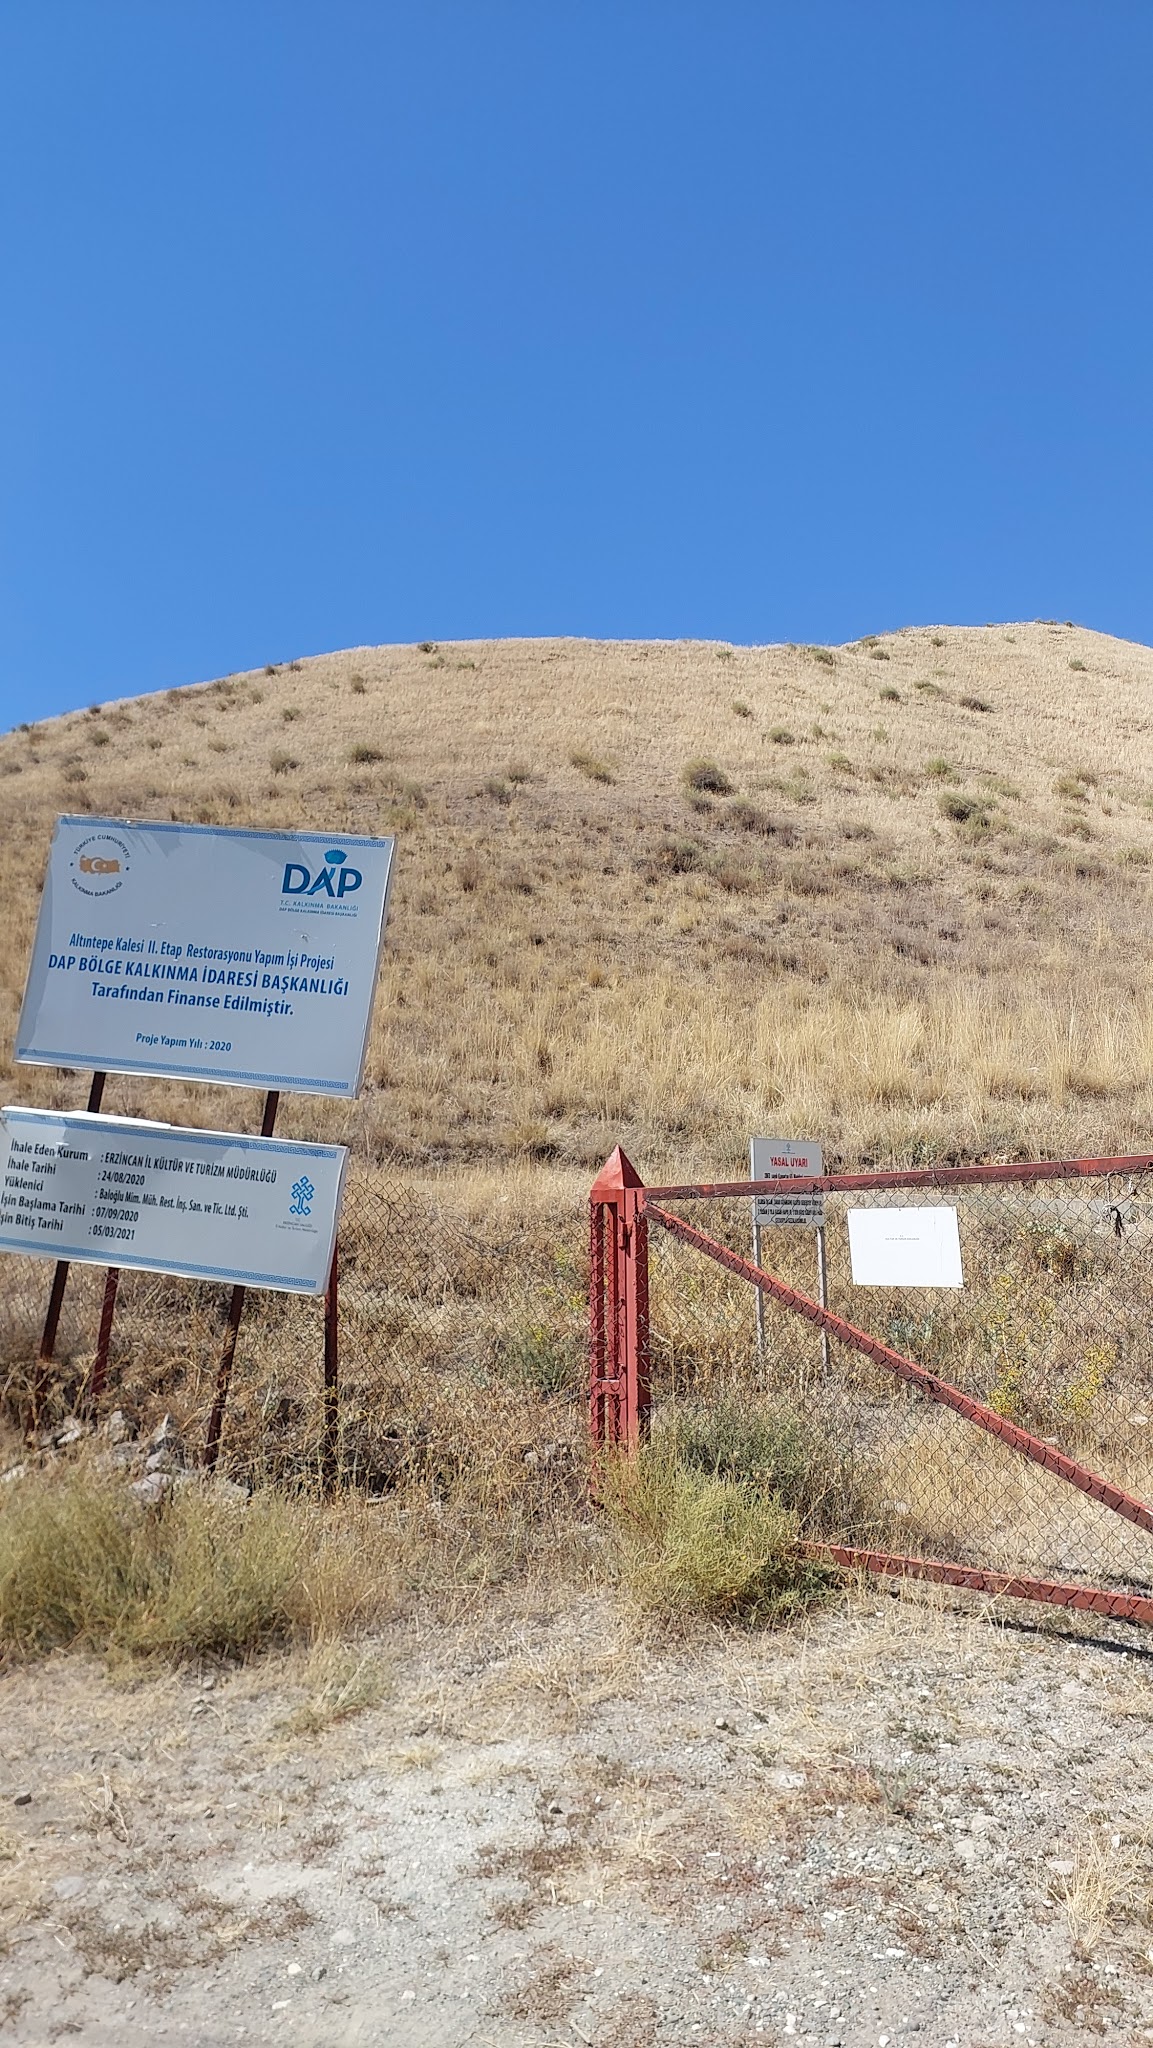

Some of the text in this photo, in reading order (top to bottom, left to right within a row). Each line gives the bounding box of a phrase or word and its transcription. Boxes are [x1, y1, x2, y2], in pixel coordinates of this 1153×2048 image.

[282, 863, 363, 898] DAP
[326, 903, 359, 912] BAKANLIĞI
[69, 933, 334, 972] Altıntepe Kalesi II. Etap Restorasyonu Yapım İşi Projesi
[48, 954, 349, 996] DAP BÖLGE KALKINMA İDARESİ BAŞKANLIĞI
[92, 982, 294, 1016] Tarafından Finanse Edilmiştir.
[136, 1032, 158, 1046] Proje
[160, 1035, 187, 1048] Yapım
[190, 1038, 202, 1048] Yılı
[209, 1040, 232, 1052] 2020
[7, 1156, 29, 1172] İhale
[32, 1161, 56, 1175] Tarihi
[102, 1170, 145, 1186] 24/08/2020
[10, 1138, 32, 1154] İhale
[34, 1144, 55, 1156] Eden
[57, 1146, 88, 1160] Kurum
[104, 1152, 143, 1168] ERZİNCAN
[144, 1154, 152, 1168] İL
[154, 1156, 183, 1172] KÜLTÜR
[185, 1162, 194, 1174] VE
[196, 1162, 225, 1178] TURİZM
[226, 1165, 277, 1184] MÜDÜRLÜĞÜ
[770, 1157, 808, 1168] YASAL UYARI
[0, 1190, 16, 1208] İşin
[18, 1196, 56, 1212] Başlama
[59, 1201, 86, 1216] Tarihi
[96, 1206, 138, 1222] 07/09/2020
[4, 1176, 44, 1192] Yüklenici
[100, 1188, 124, 1204] Baloğlu
[124, 1192, 141, 1204] Mim.
[142, 1194, 158, 1206] Müh.
[159, 1196, 174, 1208] Rest.
[176, 1196, 187, 1213] İnş.
[188, 1200, 202, 1212] San.
[204, 1204, 212, 1214] ve
[212, 1202, 223, 1214] Tic.
[224, 1204, 236, 1216] Ltd.
[238, 1206, 248, 1220] Şti.
[16, 1214, 36, 1230] Bitiş
[38, 1216, 64, 1231] Tarihi
[92, 1224, 135, 1240] 05/03/2021
